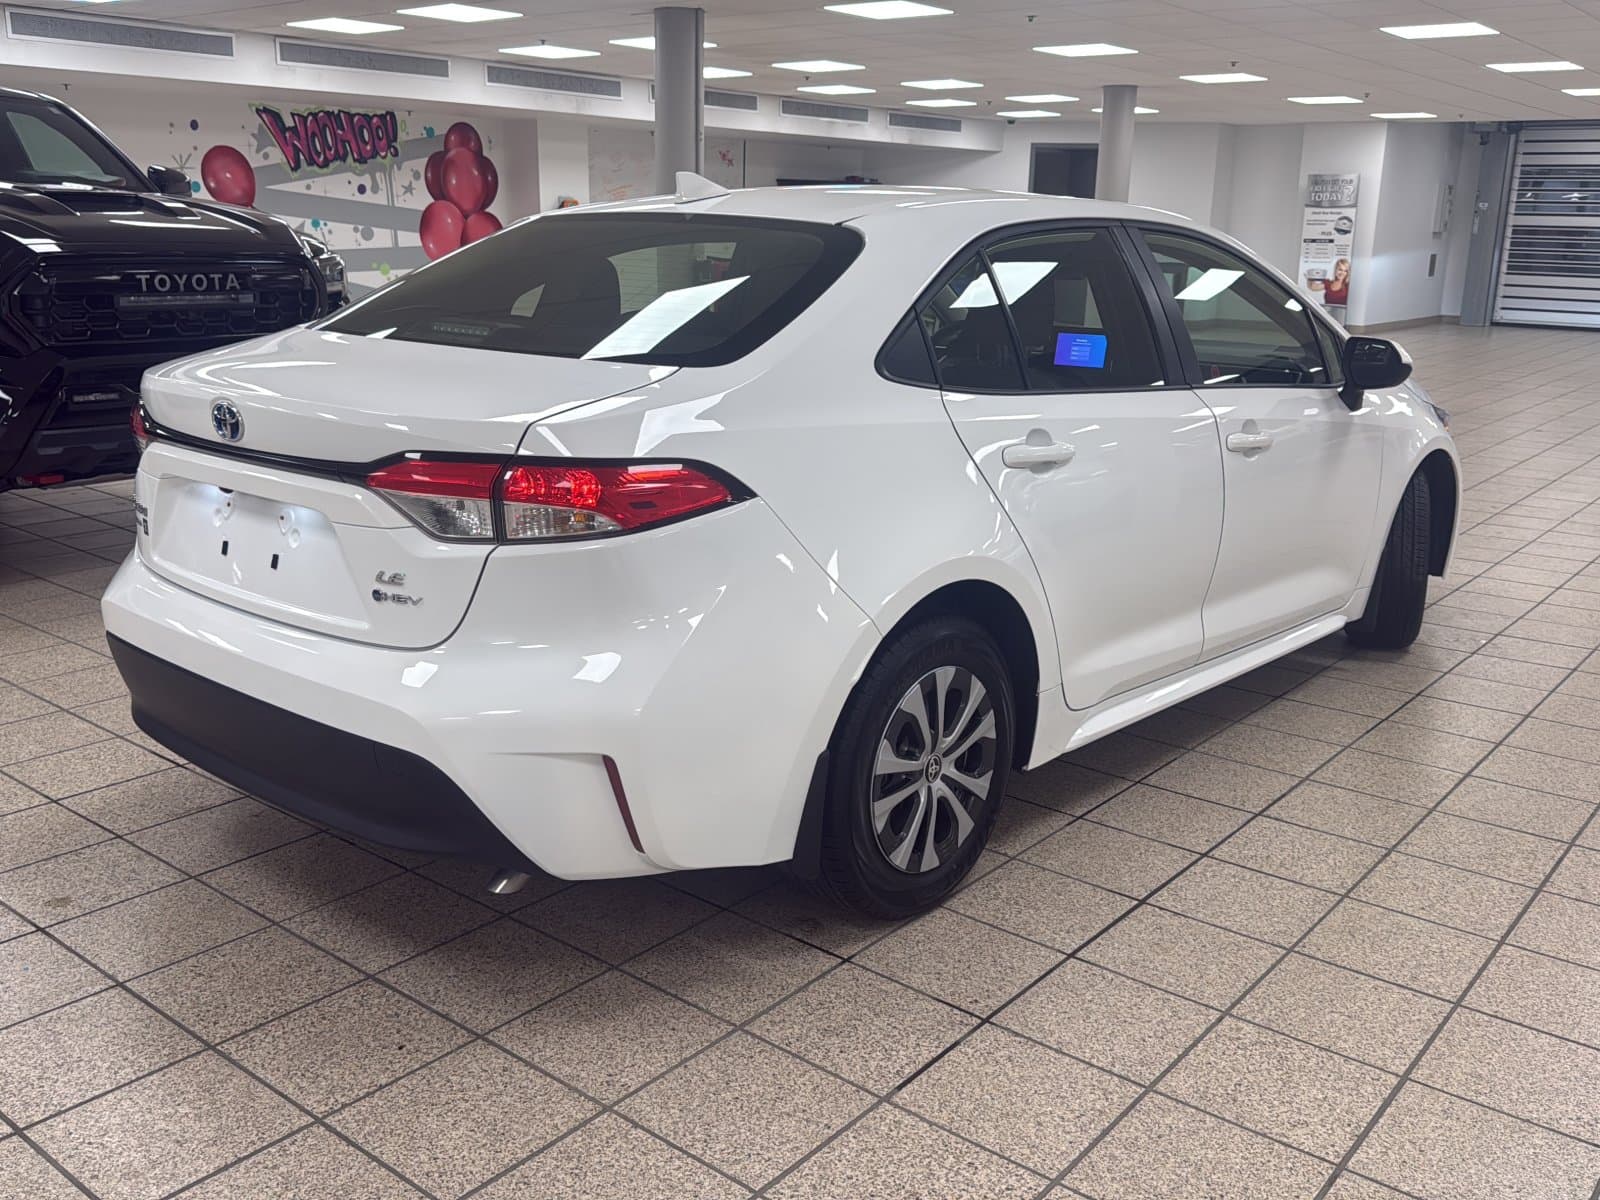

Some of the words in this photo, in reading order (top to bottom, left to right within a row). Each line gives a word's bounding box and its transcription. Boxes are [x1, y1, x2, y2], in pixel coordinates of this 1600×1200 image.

[256, 106, 398, 171] WOOHOO!
[136, 274, 240, 292] TOYOTA
[375, 570, 406, 587] LE
